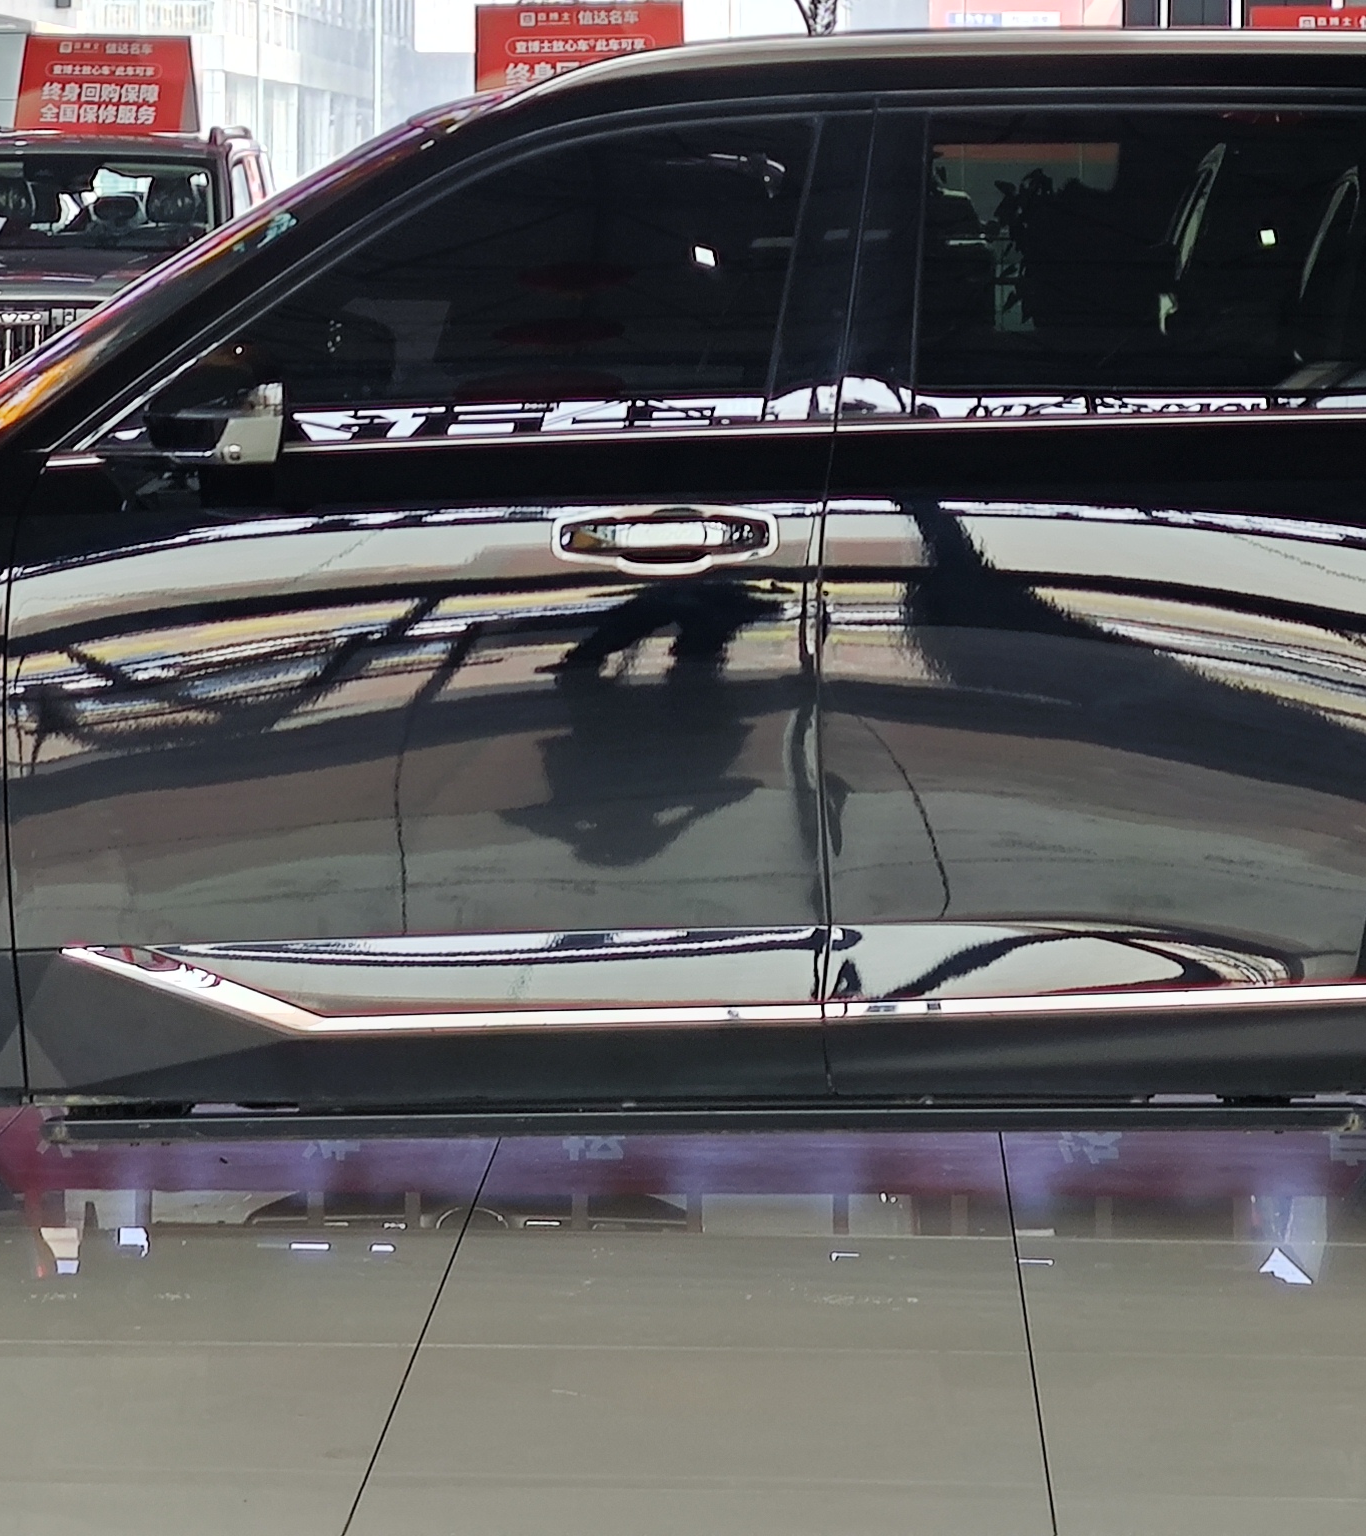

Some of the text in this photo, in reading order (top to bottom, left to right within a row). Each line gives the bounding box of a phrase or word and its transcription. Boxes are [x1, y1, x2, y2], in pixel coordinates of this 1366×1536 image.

[577, 9, 640, 26] 信达名车
[40, 81, 160, 103] 终身回购保障
[39, 104, 157, 125] 全国保修服务
